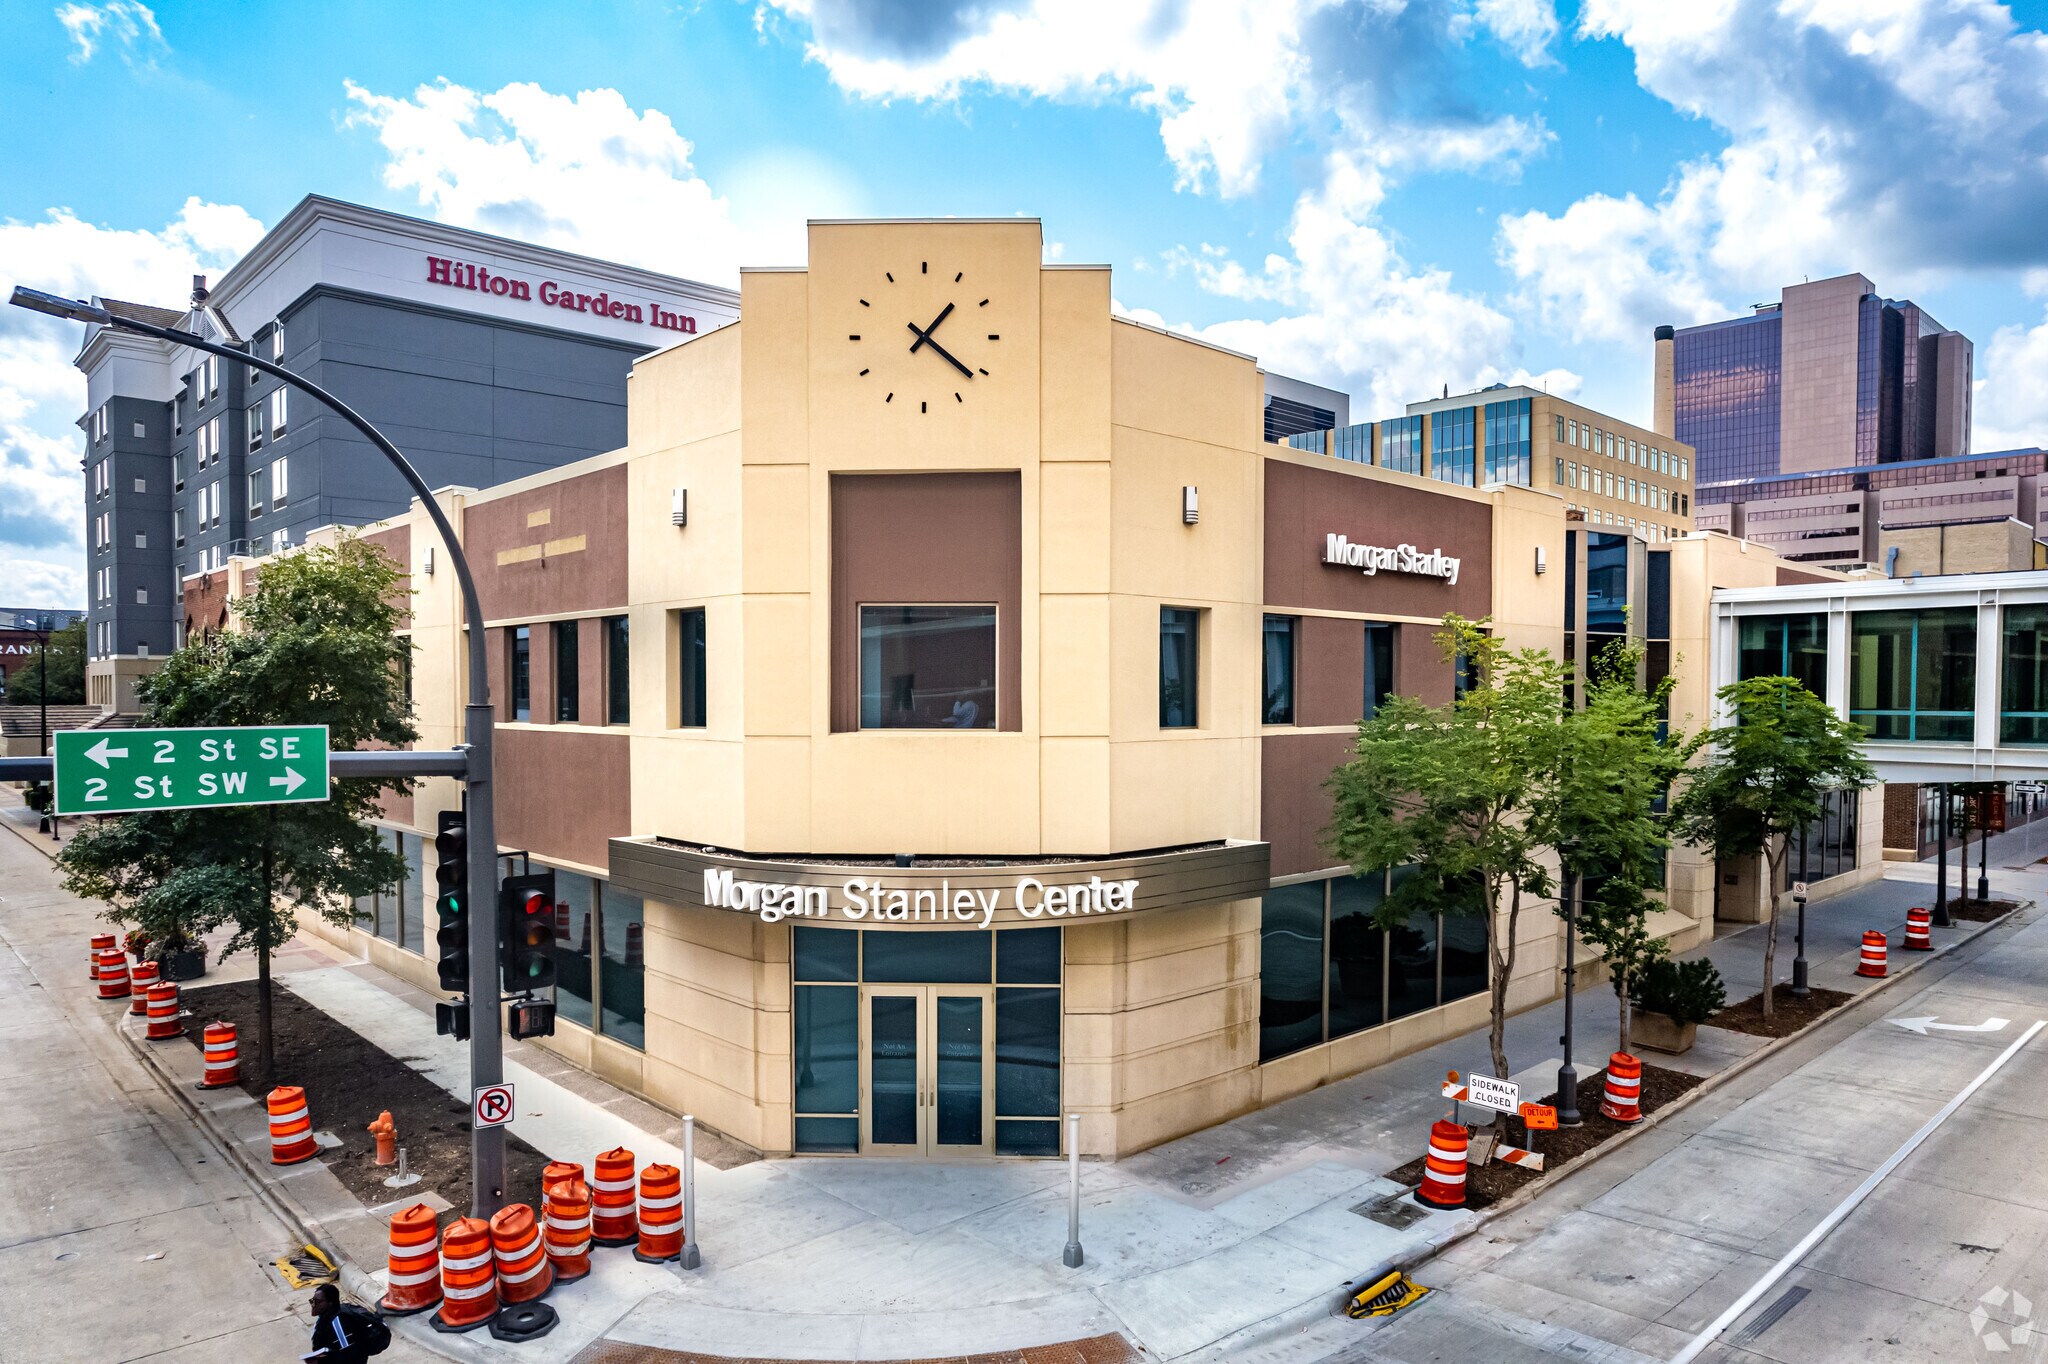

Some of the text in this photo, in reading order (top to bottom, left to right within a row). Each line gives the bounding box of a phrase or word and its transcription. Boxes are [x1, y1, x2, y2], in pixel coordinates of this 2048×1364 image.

[427, 256, 698, 334] Hilton Garden Inn
[153, 736, 301, 763] 2 St SE
[84, 771, 248, 802] 2 St SW
[703, 868, 1140, 929] Morgan Stanley Center
[1471, 1078, 1516, 1096] SIDEWALK
[487, 1094, 505, 1117] P
[1475, 1092, 1511, 1108] CLOSED
[1527, 1108, 1553, 1117] DETOUR
